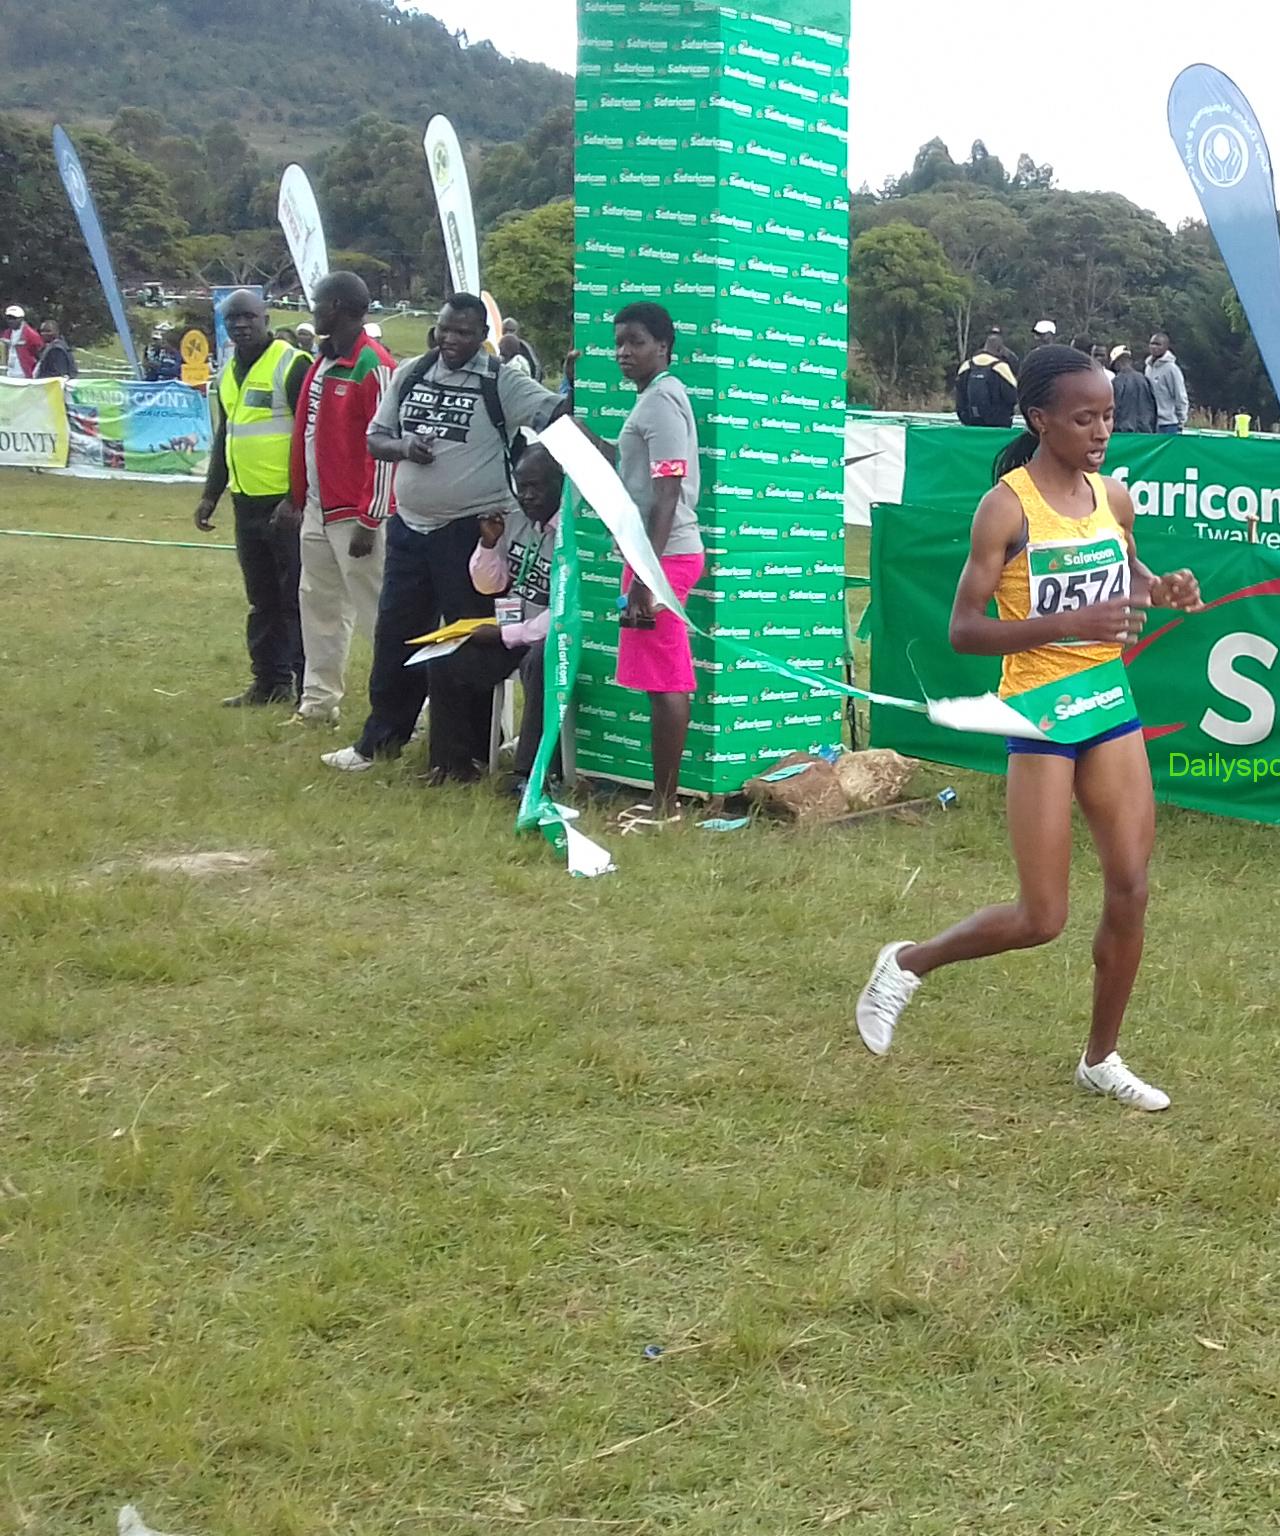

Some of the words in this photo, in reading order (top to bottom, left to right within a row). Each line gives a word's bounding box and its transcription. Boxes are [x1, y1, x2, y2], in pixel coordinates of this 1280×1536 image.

[0, 431, 58, 453] OUNTY
[1063, 547, 1115, 567] Safaricom
[1036, 564, 1125, 616] 0574
[1054, 686, 1124, 720] Safaricom
